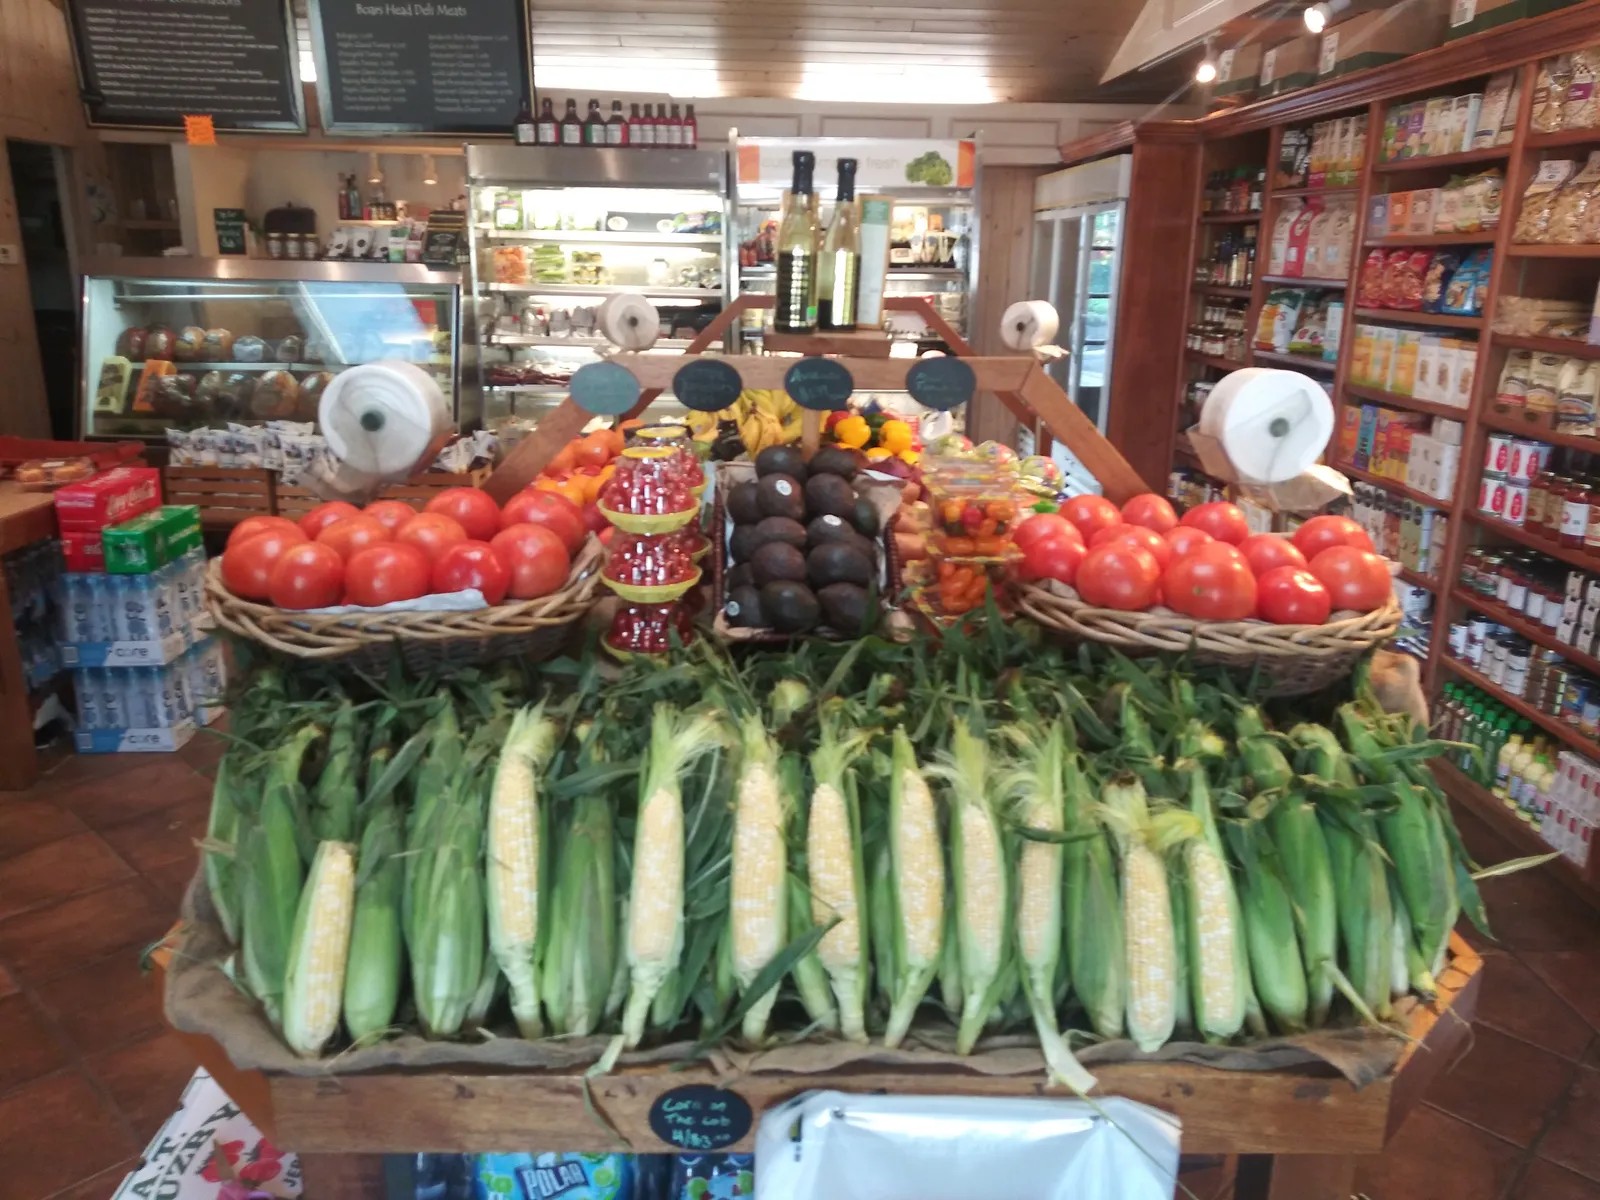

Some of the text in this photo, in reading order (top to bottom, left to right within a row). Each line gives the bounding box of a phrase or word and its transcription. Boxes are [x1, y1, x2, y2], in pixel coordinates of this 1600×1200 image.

[385, 3, 413, 16] Head
[414, 2, 435, 16] Deli
[436, 4, 468, 17] Meats
[865, 155, 899, 169] fresh
[148, 1102, 240, 1200] UZBY
[520, 1162, 586, 1200] POLAR
